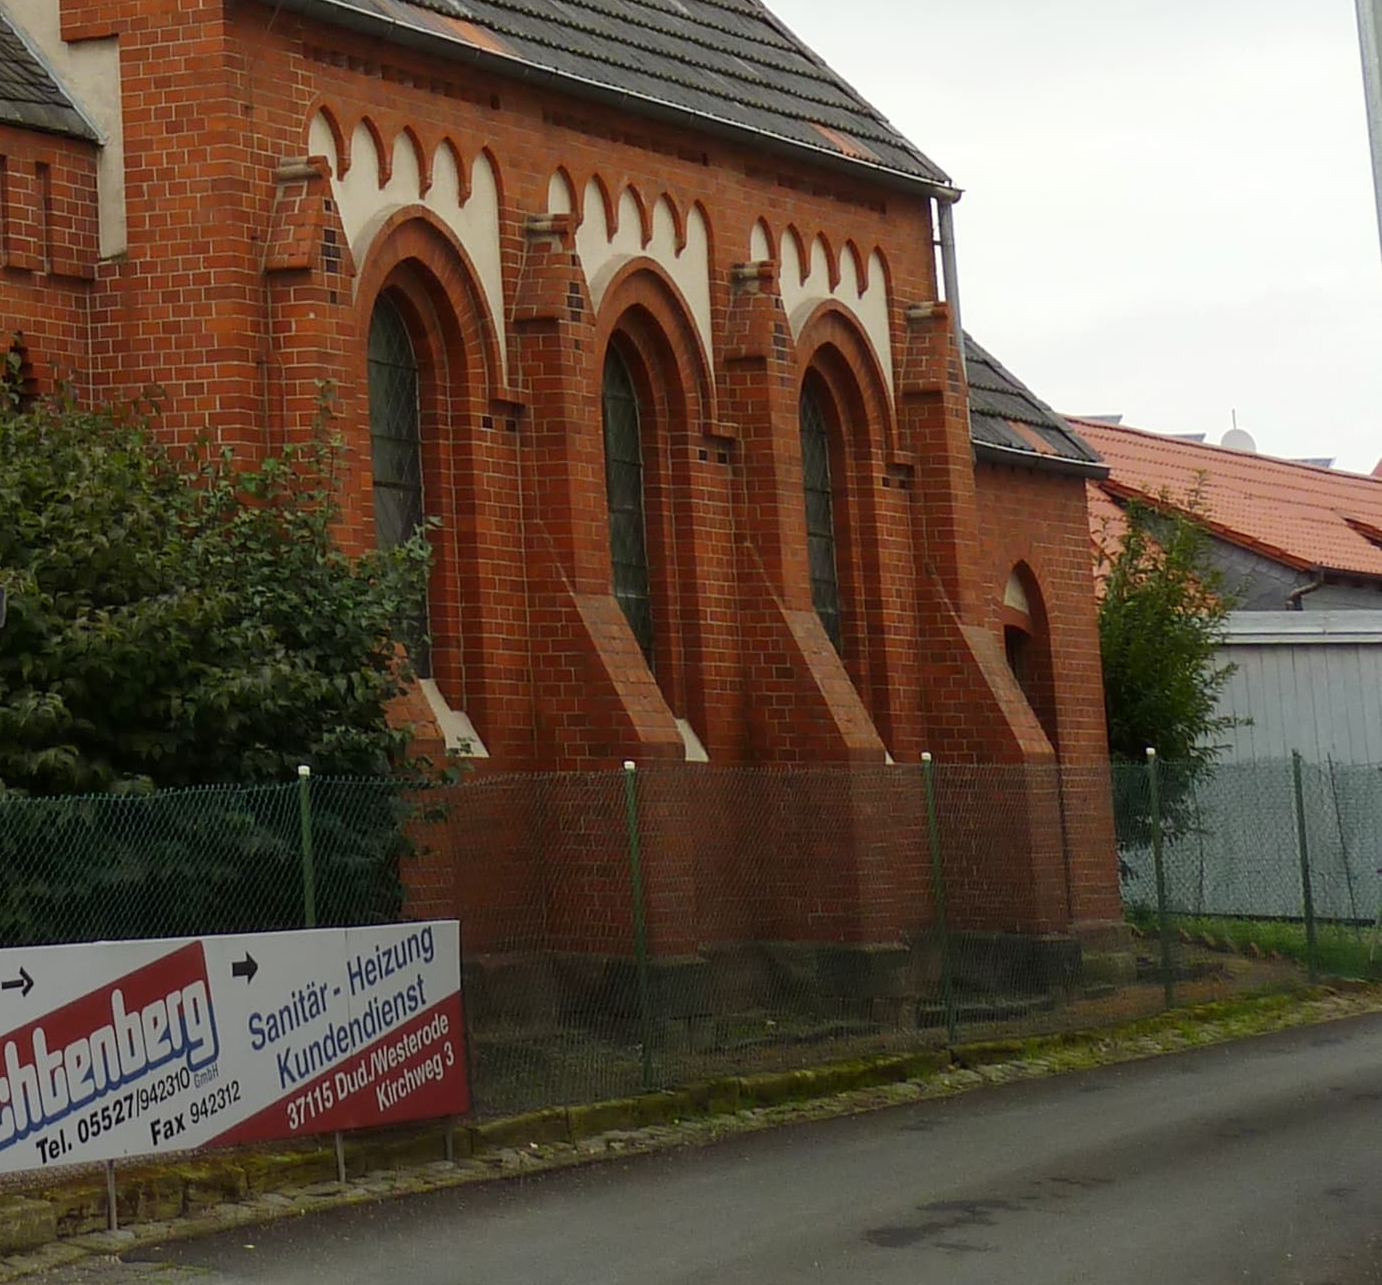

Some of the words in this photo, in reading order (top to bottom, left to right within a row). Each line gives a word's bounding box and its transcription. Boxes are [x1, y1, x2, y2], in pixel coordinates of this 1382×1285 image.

[248, 981, 328, 1051] Sanitär
[347, 925, 435, 996] Heizung
[276, 973, 427, 1090] Kundendienst
[193, 1063, 219, 1089] GmbH
[287, 1080, 334, 1130] 37115
[376, 1053, 444, 1112] Kirchweg
[444, 1041, 455, 1067] 3
[36, 1129, 72, 1165] Tel.
[77, 1066, 191, 1144] 05527/942310
[150, 1113, 187, 1146] Fax
[190, 1080, 242, 1125] 942312
